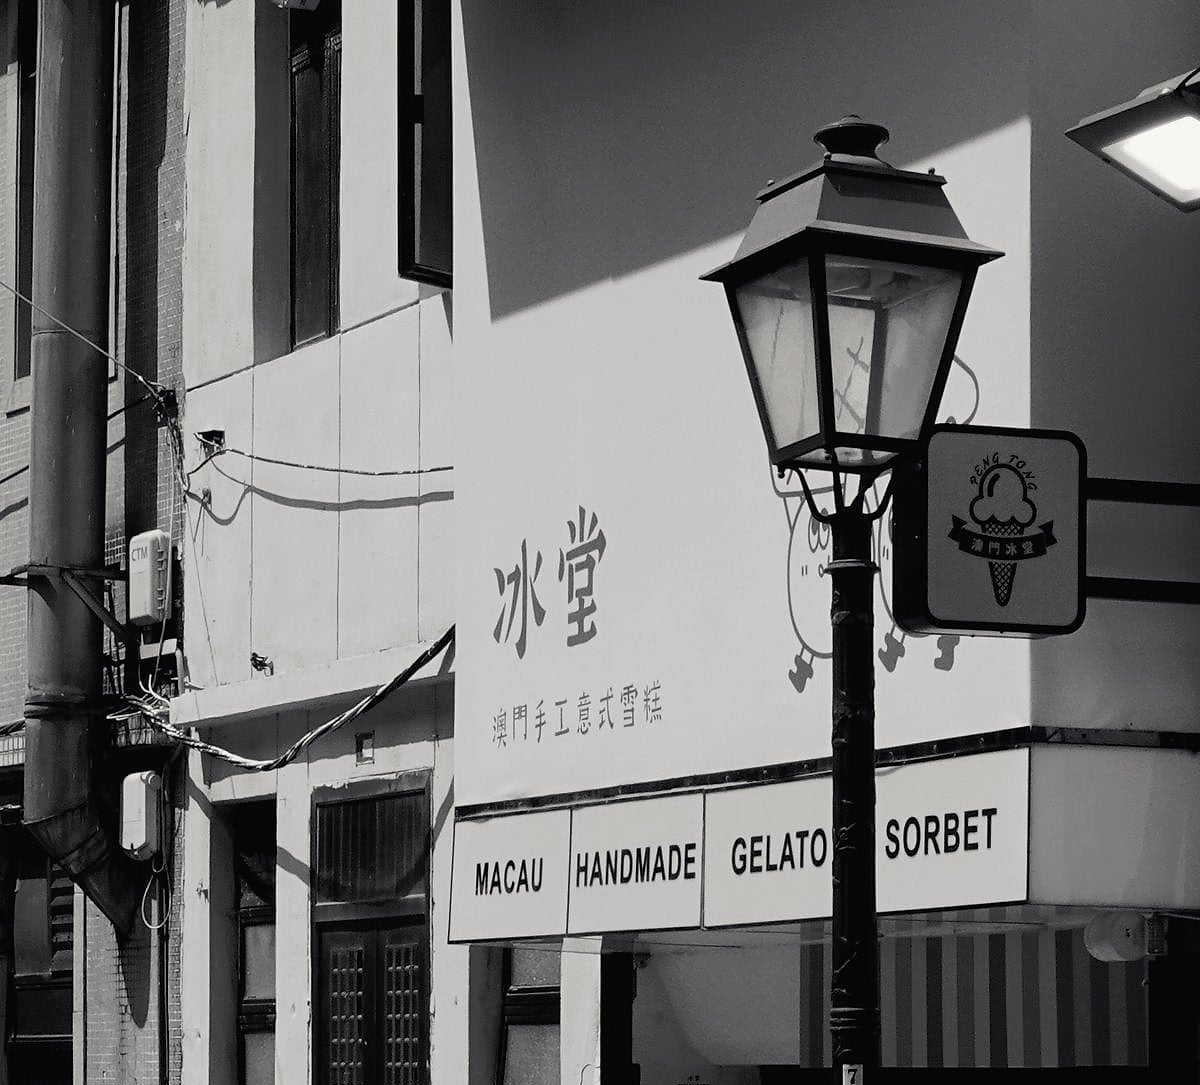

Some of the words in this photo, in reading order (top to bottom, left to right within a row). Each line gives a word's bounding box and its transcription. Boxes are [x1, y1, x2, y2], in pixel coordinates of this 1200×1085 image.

[970, 452, 999, 485] PENG
[1008, 454, 1038, 491] TONG
[131, 545, 148, 562] CTM
[971, 538, 1035, 556] 澳門冰堂
[493, 505, 607, 660] 冰堂
[492, 680, 664, 748] 澳門手工意式雪糕
[475, 857, 544, 896] MACAU
[576, 842, 697, 888] HANDMADE
[732, 828, 828, 876] GELATO
[885, 808, 998, 860] SORBET
